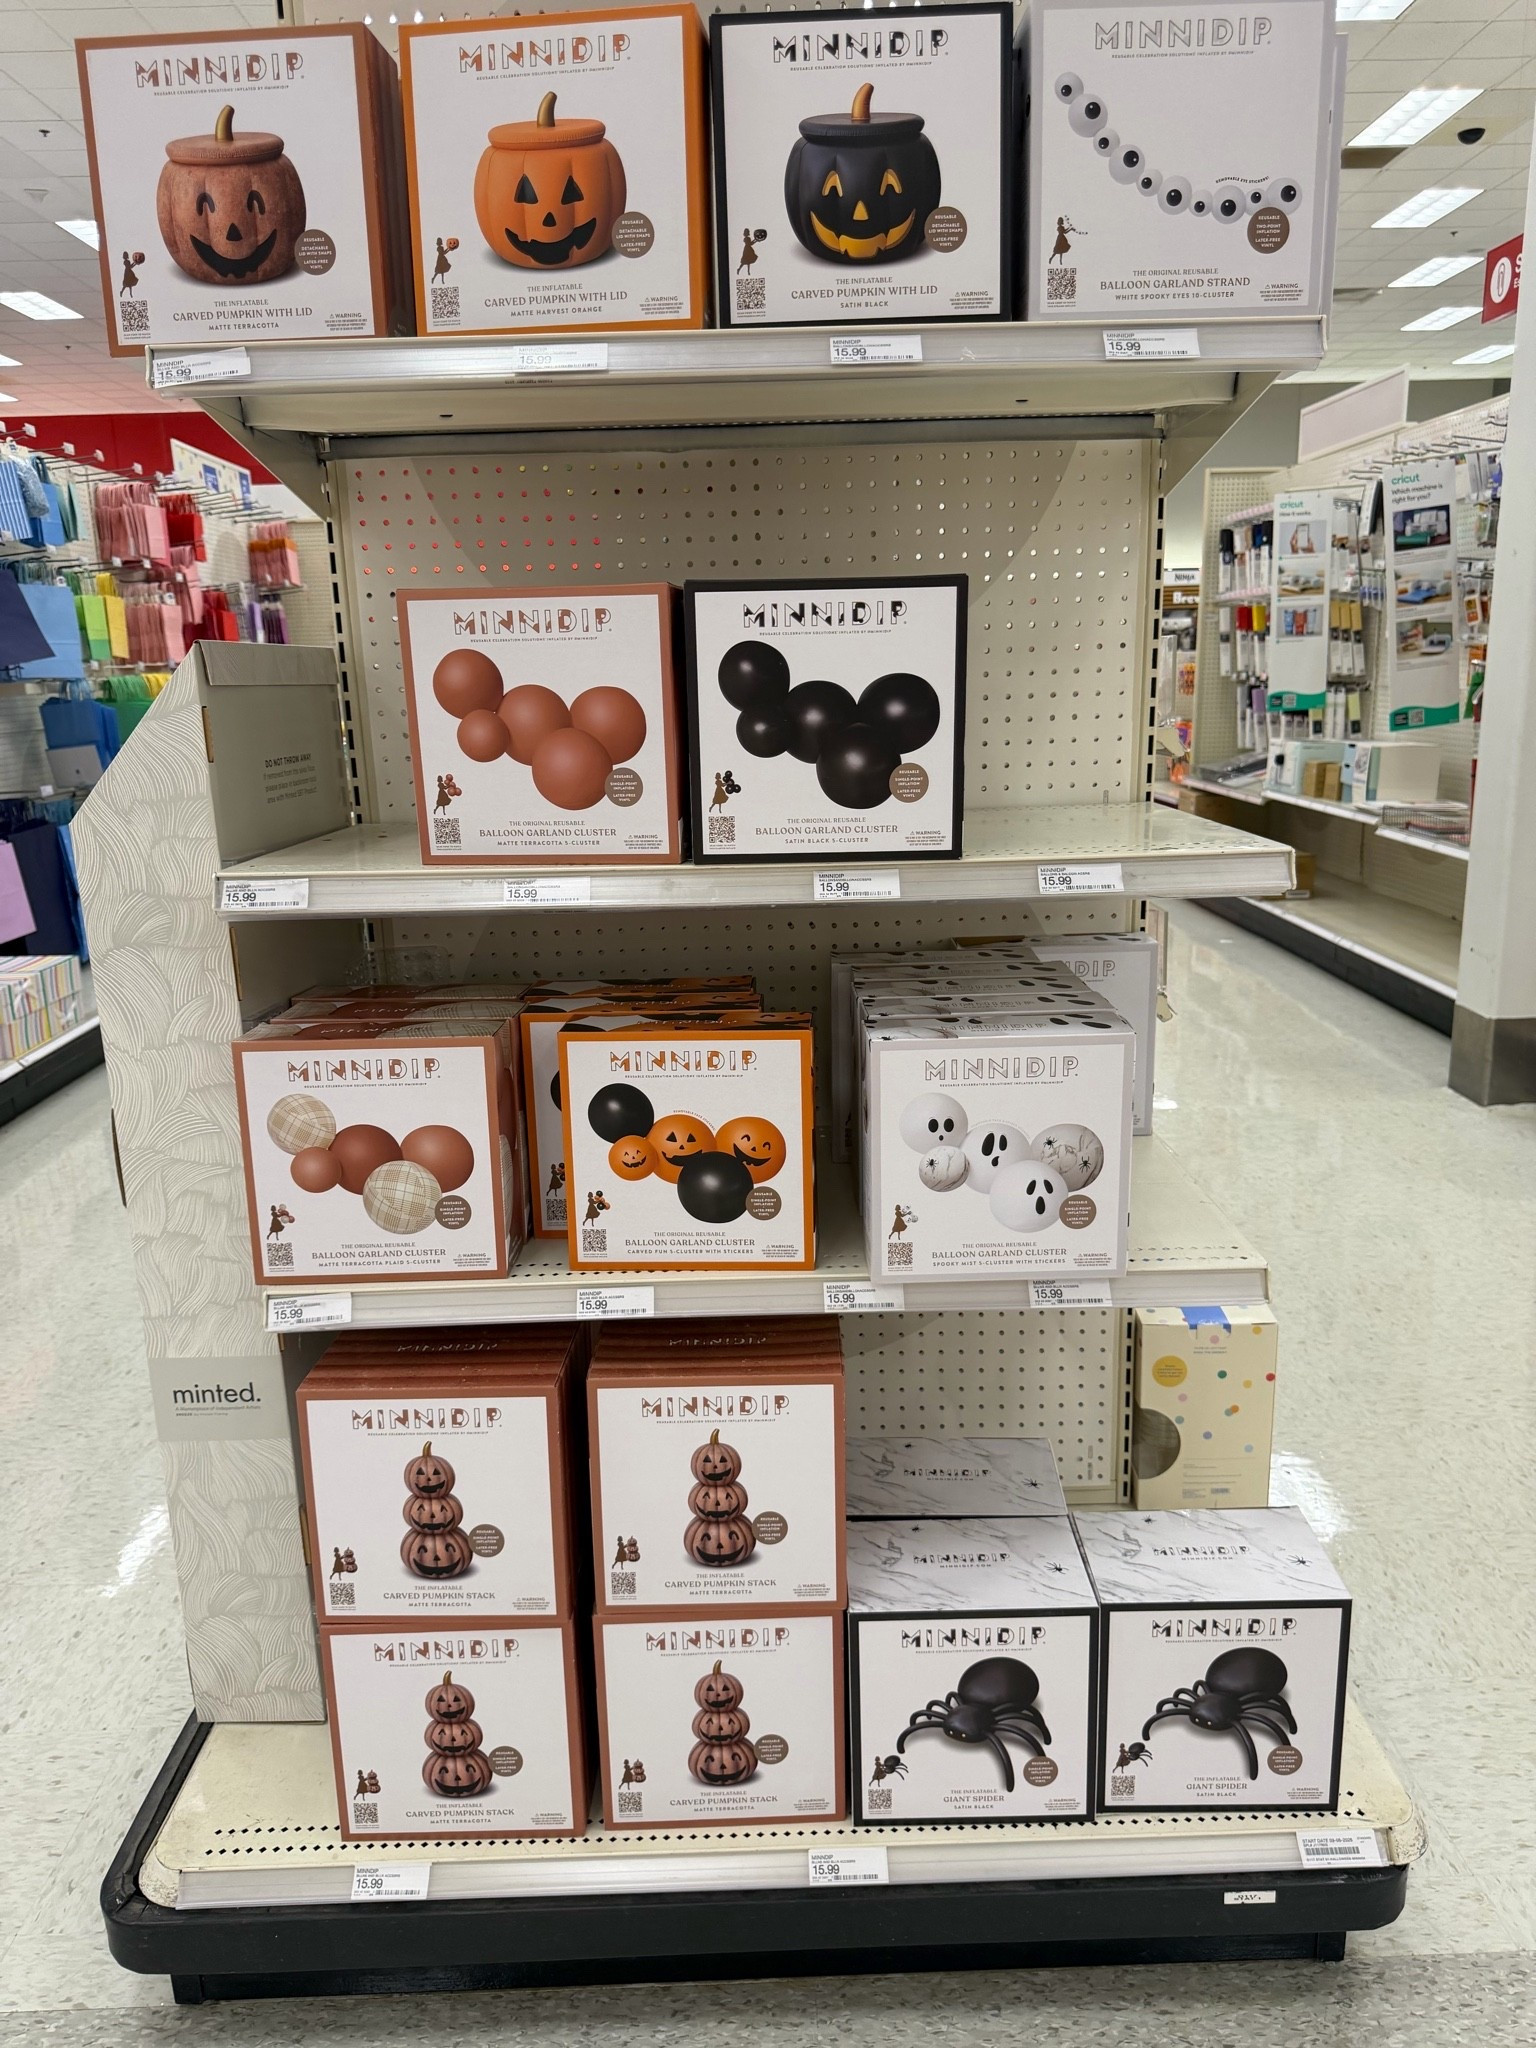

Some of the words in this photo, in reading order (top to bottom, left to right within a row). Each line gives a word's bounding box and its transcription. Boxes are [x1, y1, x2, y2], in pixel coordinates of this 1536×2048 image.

[1182, 267, 1218, 275] REUSABLE
[850, 276, 892, 284] INFLATABLE
[1100, 280, 1150, 290] BALLOON
[1153, 278, 1204, 288] GARLAND
[1206, 277, 1250, 286] STRAND
[541, 283, 582, 291] INFLATABLE
[791, 289, 834, 299] CARVED
[836, 287, 885, 297] PUMPKIN
[887, 285, 916, 295] WITH
[920, 285, 937, 294] LID
[228, 298, 268, 306] INFLATABLE
[484, 296, 526, 307] CARVED
[528, 293, 576, 304] PUMPKIN
[578, 291, 606, 302] WITH
[609, 290, 627, 300] LID
[172, 311, 213, 321] CARVED
[216, 309, 262, 319] PUMPKIN
[264, 307, 292, 317] WITH
[295, 307, 312, 316] LID
[536, 307, 568, 315] HARVEST
[1108, 341, 1141, 351] 15.99
[834, 347, 867, 357] 15.99
[520, 355, 552, 365] 15.99
[159, 368, 192, 379] 15.99
[1391, 473, 1420, 485] cricut
[265, 759, 273, 768] DO
[273, 757, 283, 767] NOT
[283, 756, 299, 765] THROW
[300, 753, 311, 762] AWAY
[479, 829, 523, 837] BALLOON
[526, 828, 571, 836] GARLAND
[573, 828, 616, 836] CLUSTER
[755, 826, 801, 835] BALLOON
[804, 825, 851, 834] GARLAND
[853, 824, 898, 833] CLUSTER
[1042, 876, 1072, 886] 15.99
[820, 882, 850, 892] 15.99
[226, 892, 257, 902] 15.99
[508, 889, 538, 899] 15.99
[311, 1251, 355, 1259] BALLOON
[357, 1250, 402, 1258] GARLAND
[404, 1248, 446, 1256] CLUSTER
[931, 1250, 975, 1258] BALLOON
[977, 1249, 1023, 1257] GARLAND
[1025, 1248, 1066, 1256] CLUSTER
[828, 1293, 855, 1303] 15.99
[1034, 1289, 1063, 1299] 15.99
[580, 1300, 608, 1310] 15.99
[275, 1308, 303, 1320] 15.99
[173, 1382, 261, 1404] minted.
[664, 1580, 701, 1588] CARVED
[703, 1579, 745, 1587] PUMPKIN
[1215, 1782, 1247, 1790] SPIDER
[669, 1798, 705, 1806] CARVED
[707, 1796, 747, 1804] PUMPKIN
[748, 1795, 778, 1803] STACK
[972, 1794, 1004, 1802] SPIDER
[486, 1808, 514, 1816] STACK
[813, 1864, 840, 1875] 15.99
[357, 1878, 383, 1889] 15.99
